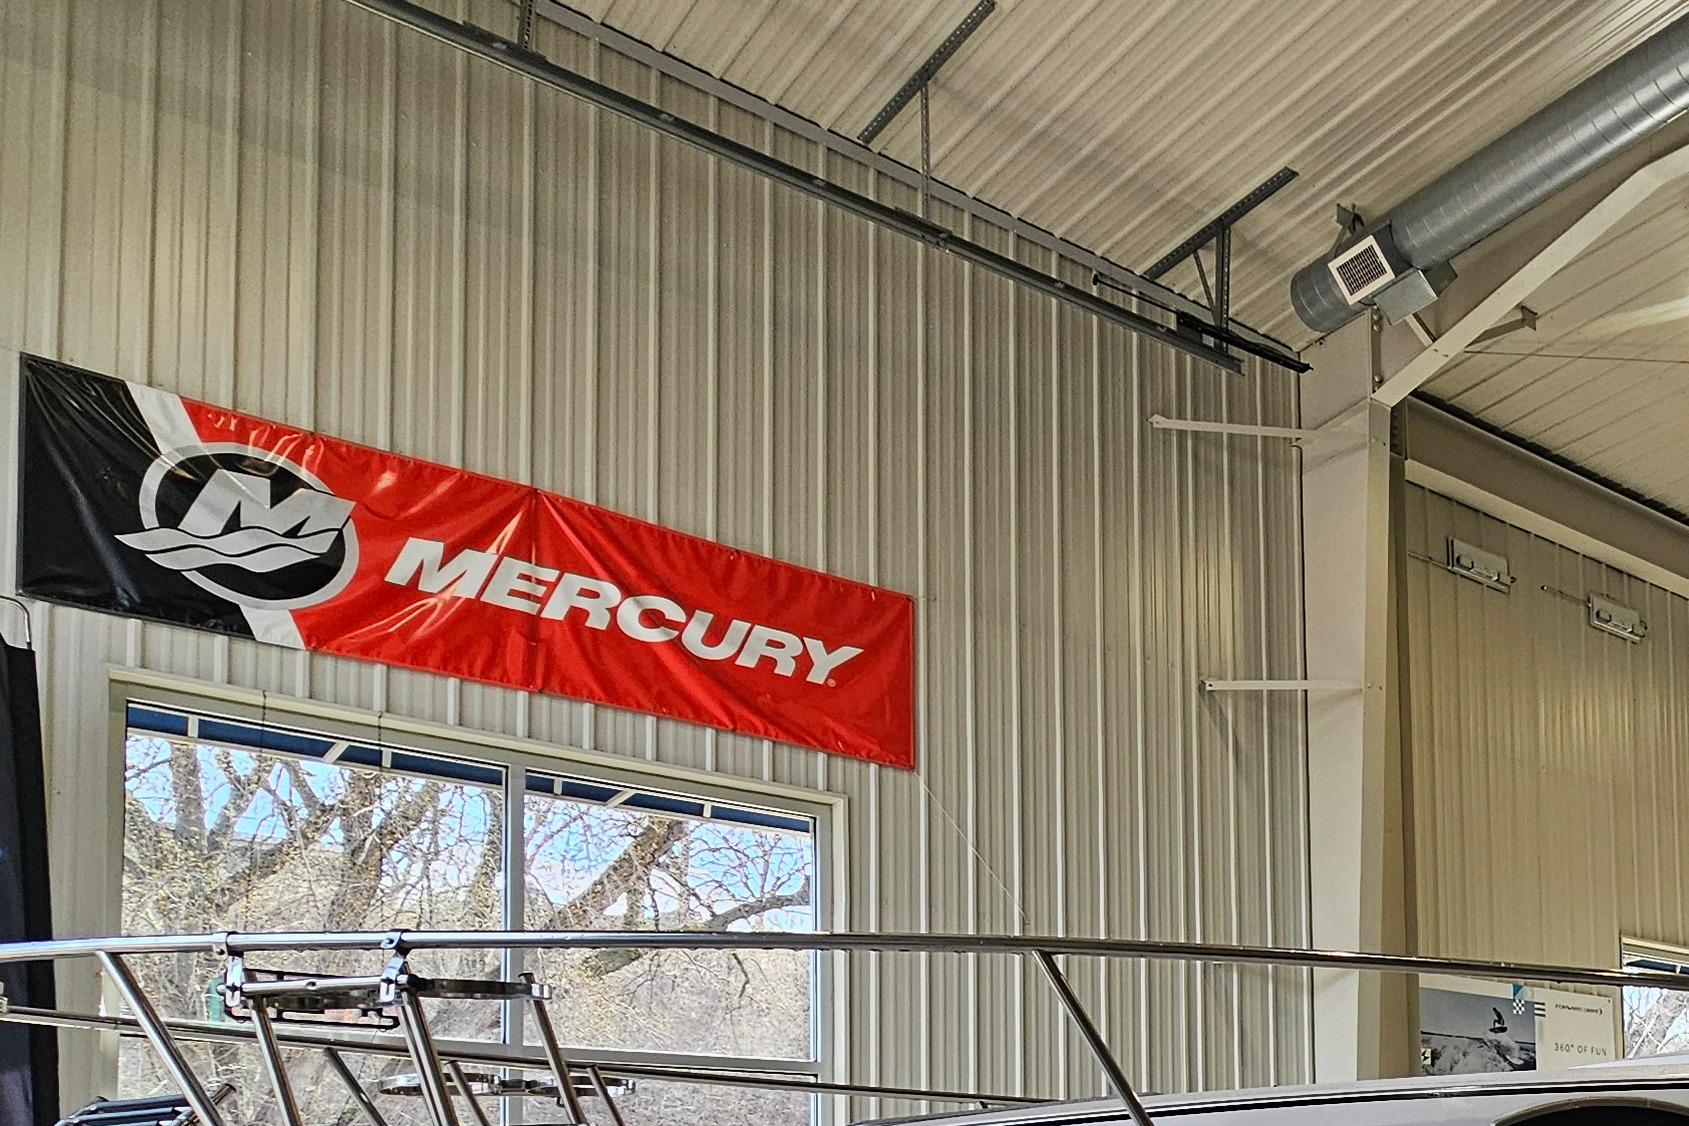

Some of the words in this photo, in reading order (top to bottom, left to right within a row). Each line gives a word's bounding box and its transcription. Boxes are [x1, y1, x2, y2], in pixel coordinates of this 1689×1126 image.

[384, 536, 864, 686] MERCURY
[1576, 1045, 1588, 1054] OF
[1590, 1046, 1607, 1057] FUN
